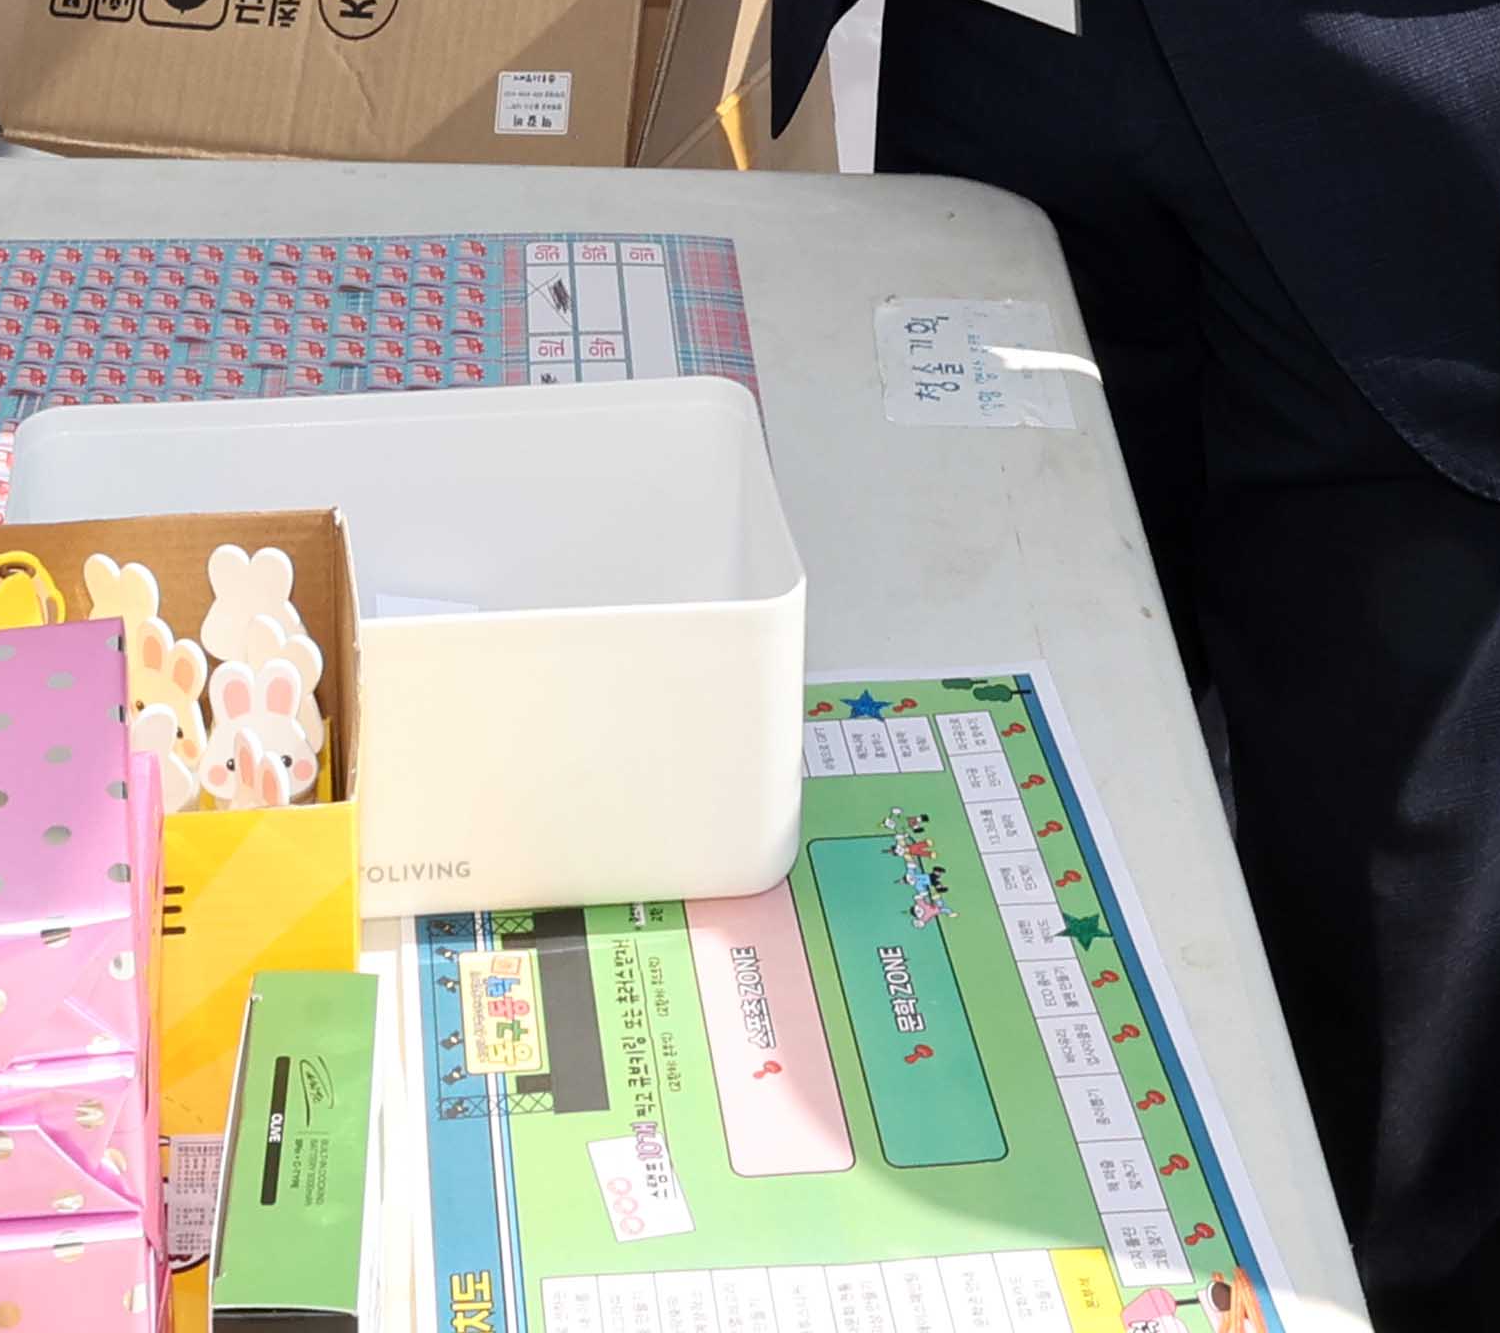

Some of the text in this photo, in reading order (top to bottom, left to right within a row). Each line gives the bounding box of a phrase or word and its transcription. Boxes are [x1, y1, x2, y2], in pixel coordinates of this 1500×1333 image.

[731, 945, 776, 1049] 스포츠 ZONE
[877, 945, 926, 1033] 문학 ZONE
[269, 1113, 283, 1143] OLIVE
